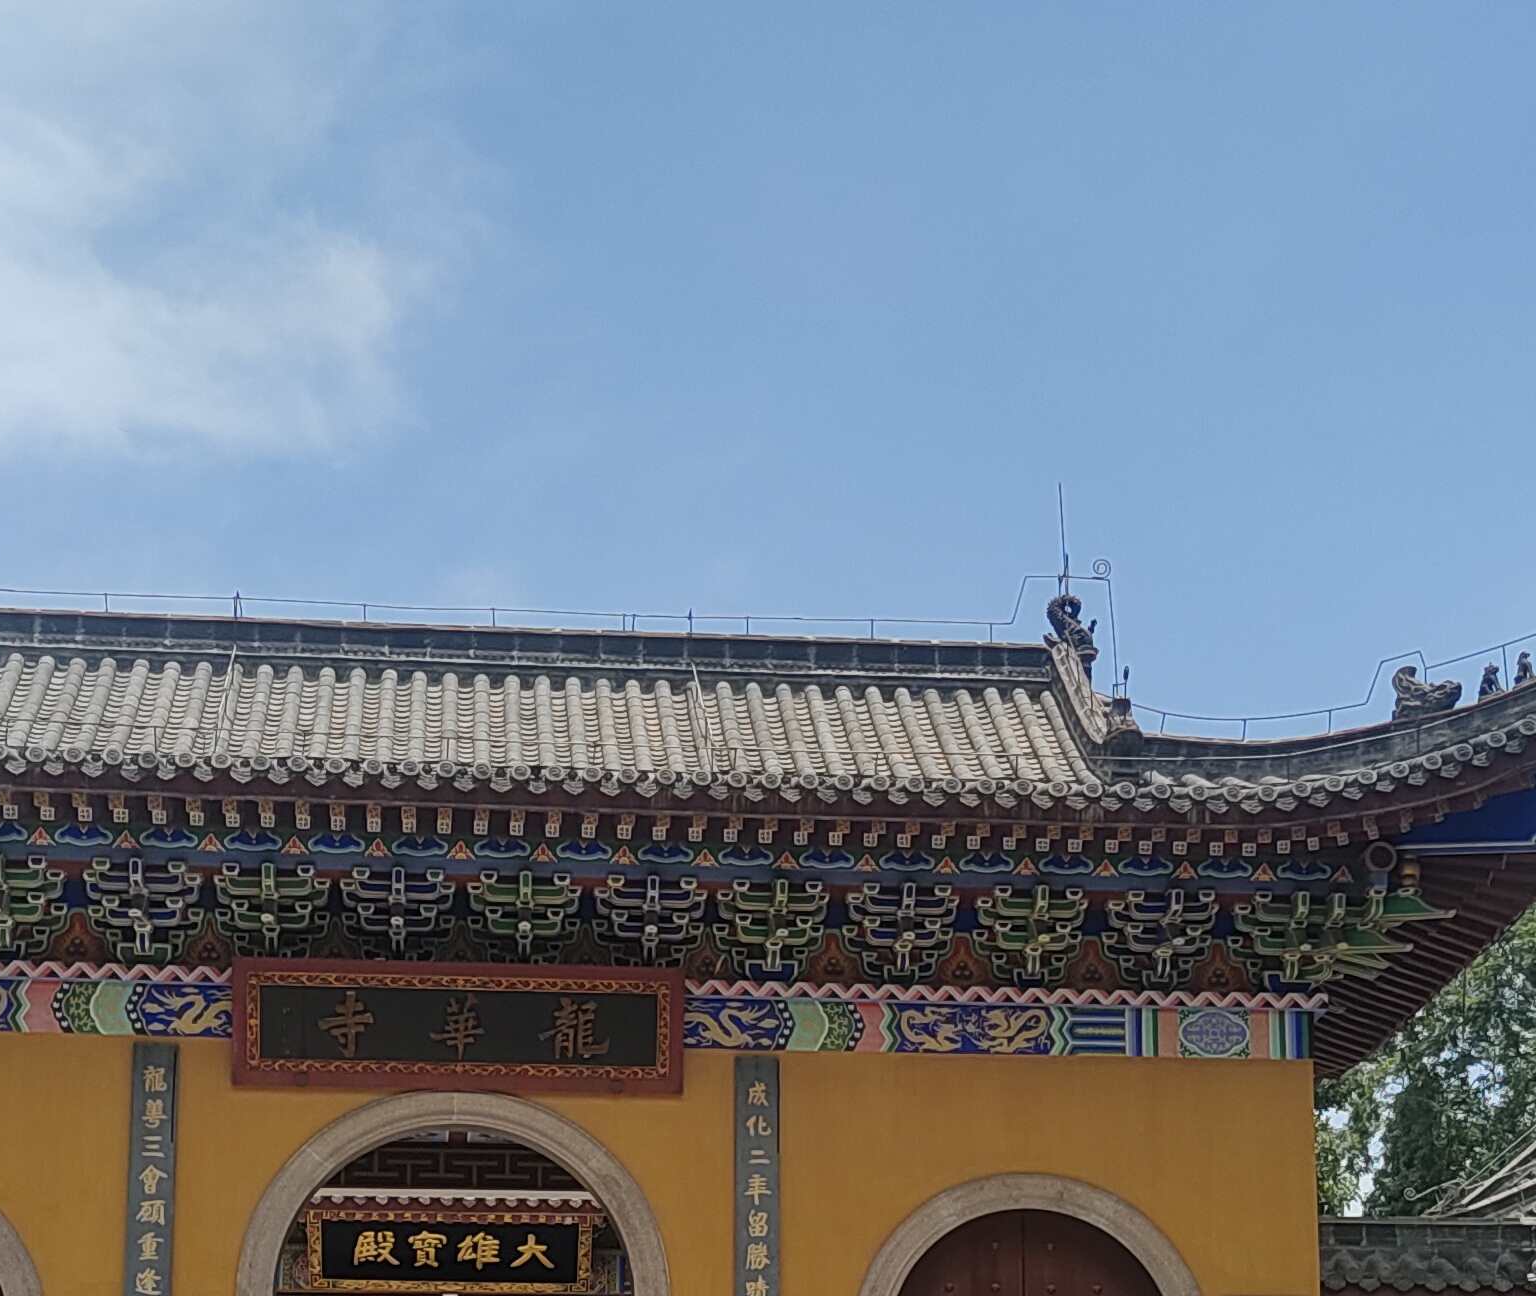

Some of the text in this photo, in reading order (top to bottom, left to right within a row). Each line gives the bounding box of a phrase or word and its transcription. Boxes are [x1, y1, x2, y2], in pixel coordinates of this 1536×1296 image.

[317, 989, 610, 1061] 龍華寺
[352, 1229, 557, 1271] 大雄寶殿
